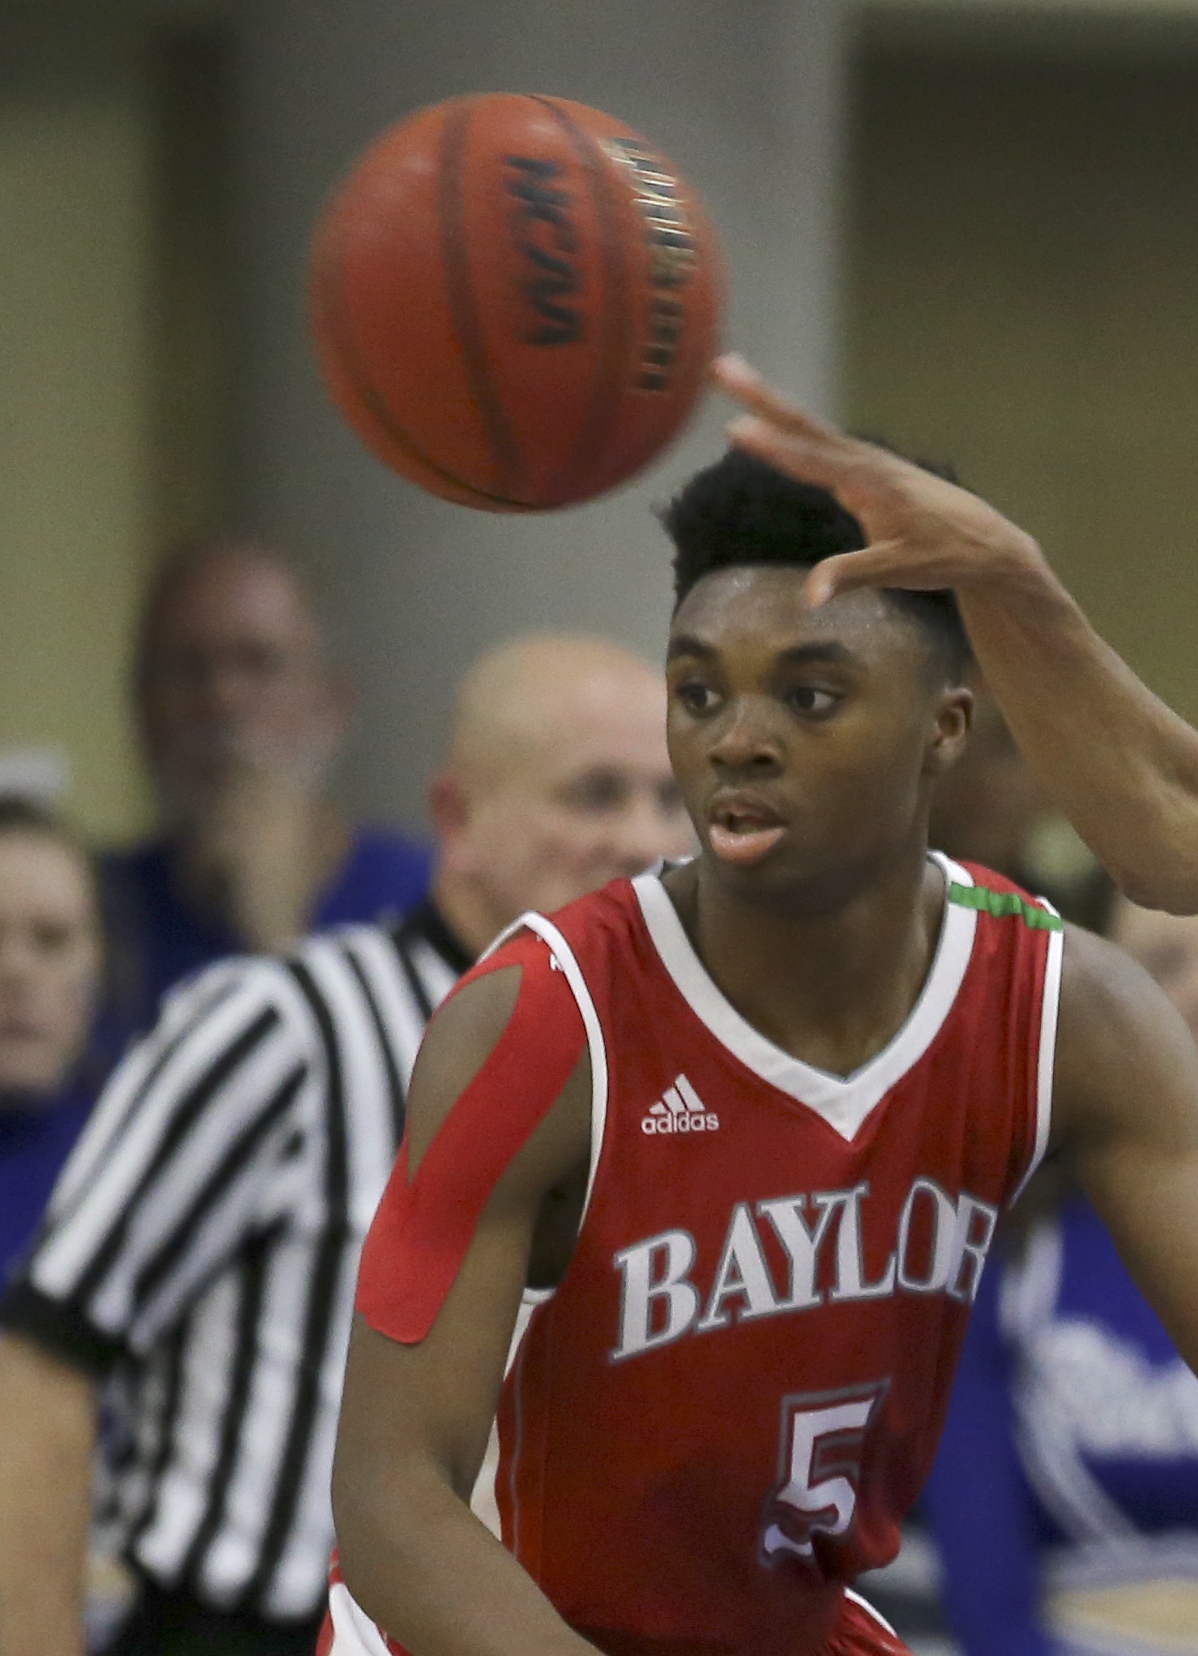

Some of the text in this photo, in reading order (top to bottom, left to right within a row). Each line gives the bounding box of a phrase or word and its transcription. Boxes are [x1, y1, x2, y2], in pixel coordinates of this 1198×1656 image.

[641, 1111, 720, 1135] adidas
[608, 1176, 999, 1364] BAYLOR
[758, 1376, 892, 1568] 5
